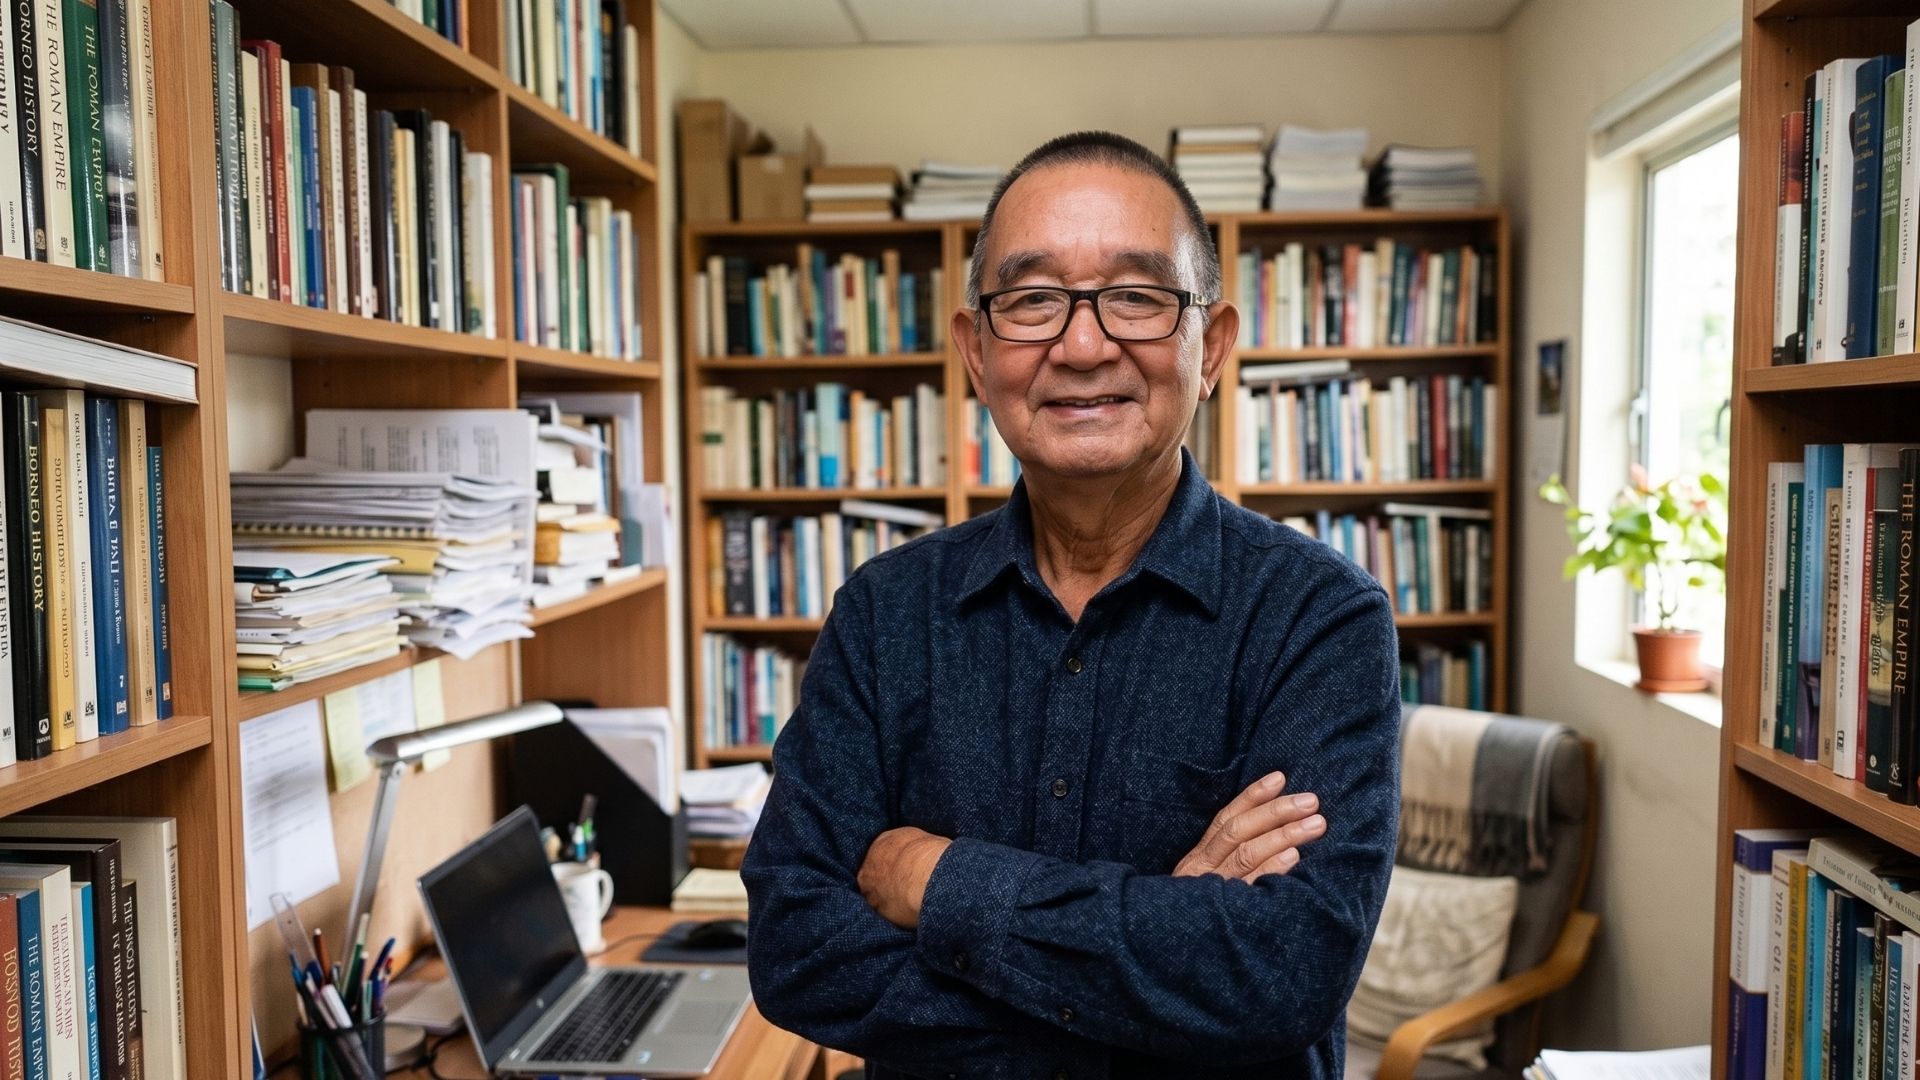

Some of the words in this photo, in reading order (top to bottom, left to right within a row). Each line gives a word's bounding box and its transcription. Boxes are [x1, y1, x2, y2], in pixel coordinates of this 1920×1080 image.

[19, 0, 33, 69] ORNEO
[84, 25, 96, 58] THE
[48, 37, 62, 115] ROMAN
[23, 75, 38, 156] HISTORY
[53, 121, 66, 191] EMPIRE
[29, 445, 40, 523] BORNEO
[1901, 479, 1914, 522] THE
[32, 531, 44, 612] HISTORY
[1898, 530, 1911, 610] ROMAN
[1894, 617, 1909, 695] EMPIRE
[27, 933, 38, 968] THE
[29, 970, 41, 1033] ROMAN
